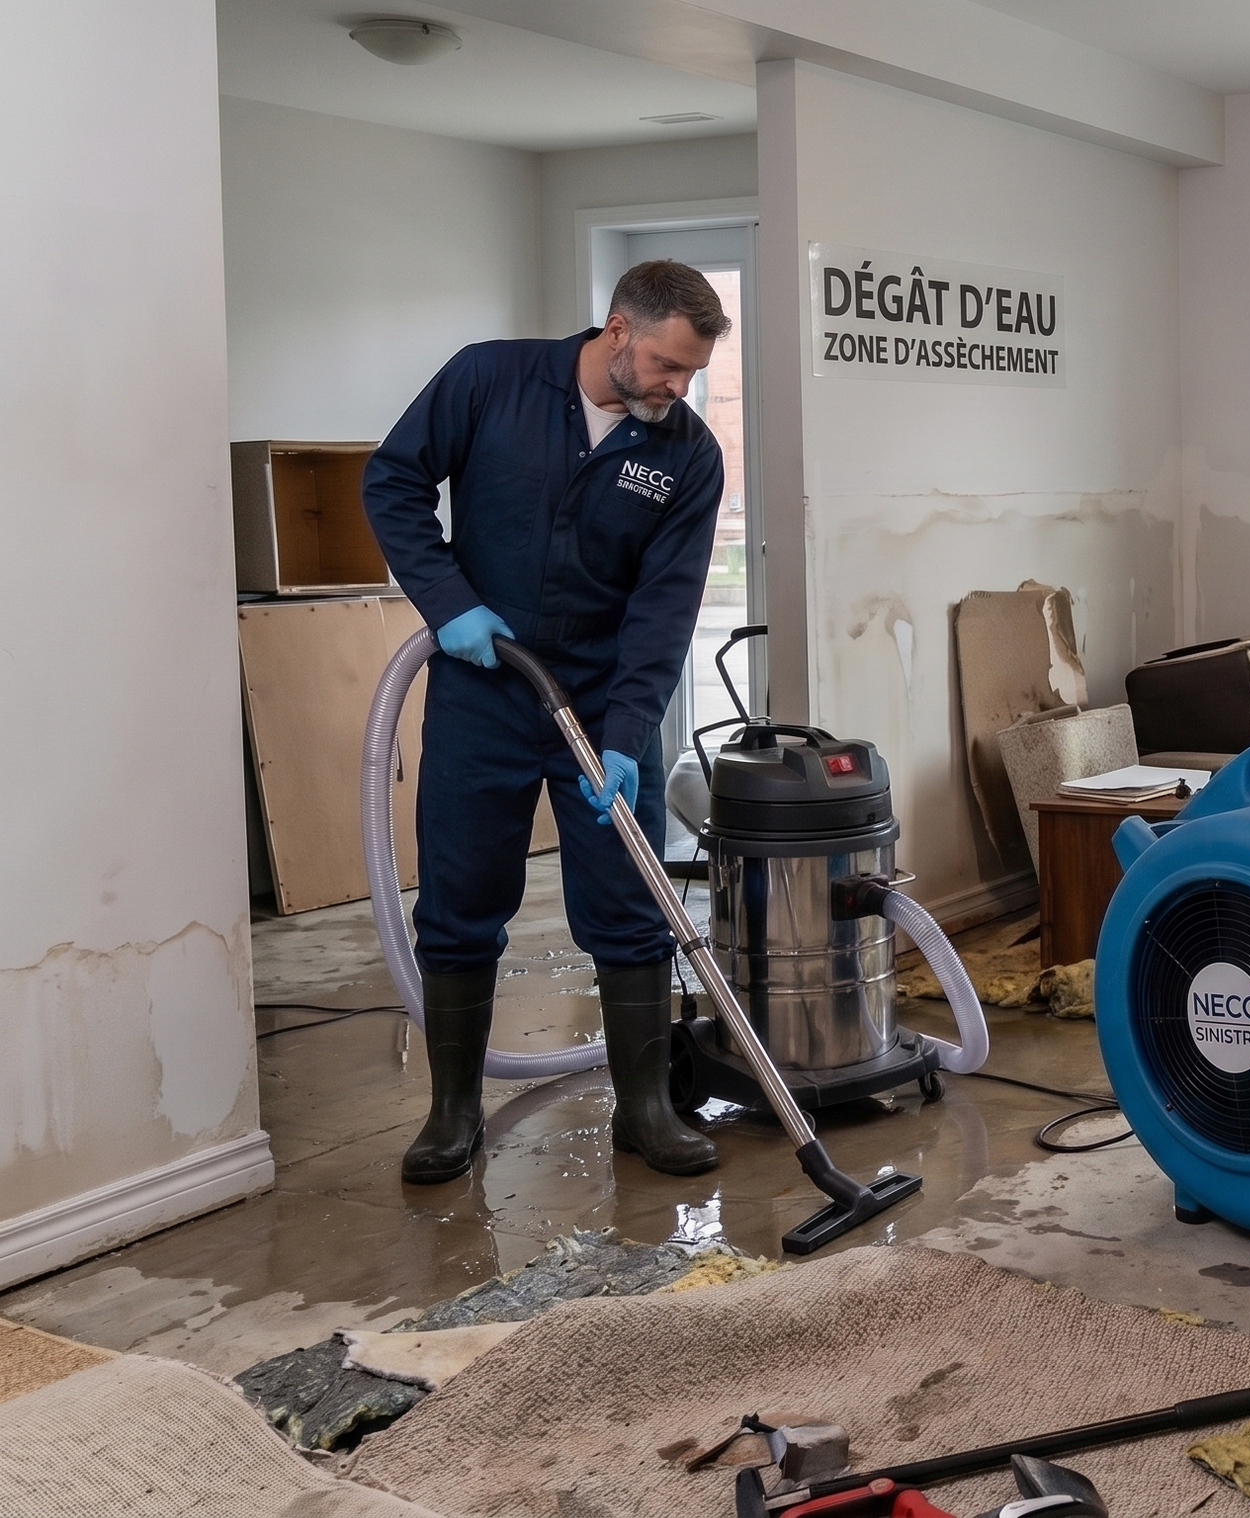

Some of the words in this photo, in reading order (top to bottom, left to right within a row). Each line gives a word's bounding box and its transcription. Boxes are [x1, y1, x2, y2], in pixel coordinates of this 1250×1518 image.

[823, 260, 950, 326] DÉGÂT
[960, 283, 1056, 337] D’EAU
[823, 332, 888, 365] ZONE
[894, 337, 1059, 375] D’ASSÈCHEMENT
[620, 460, 674, 491] NECC
